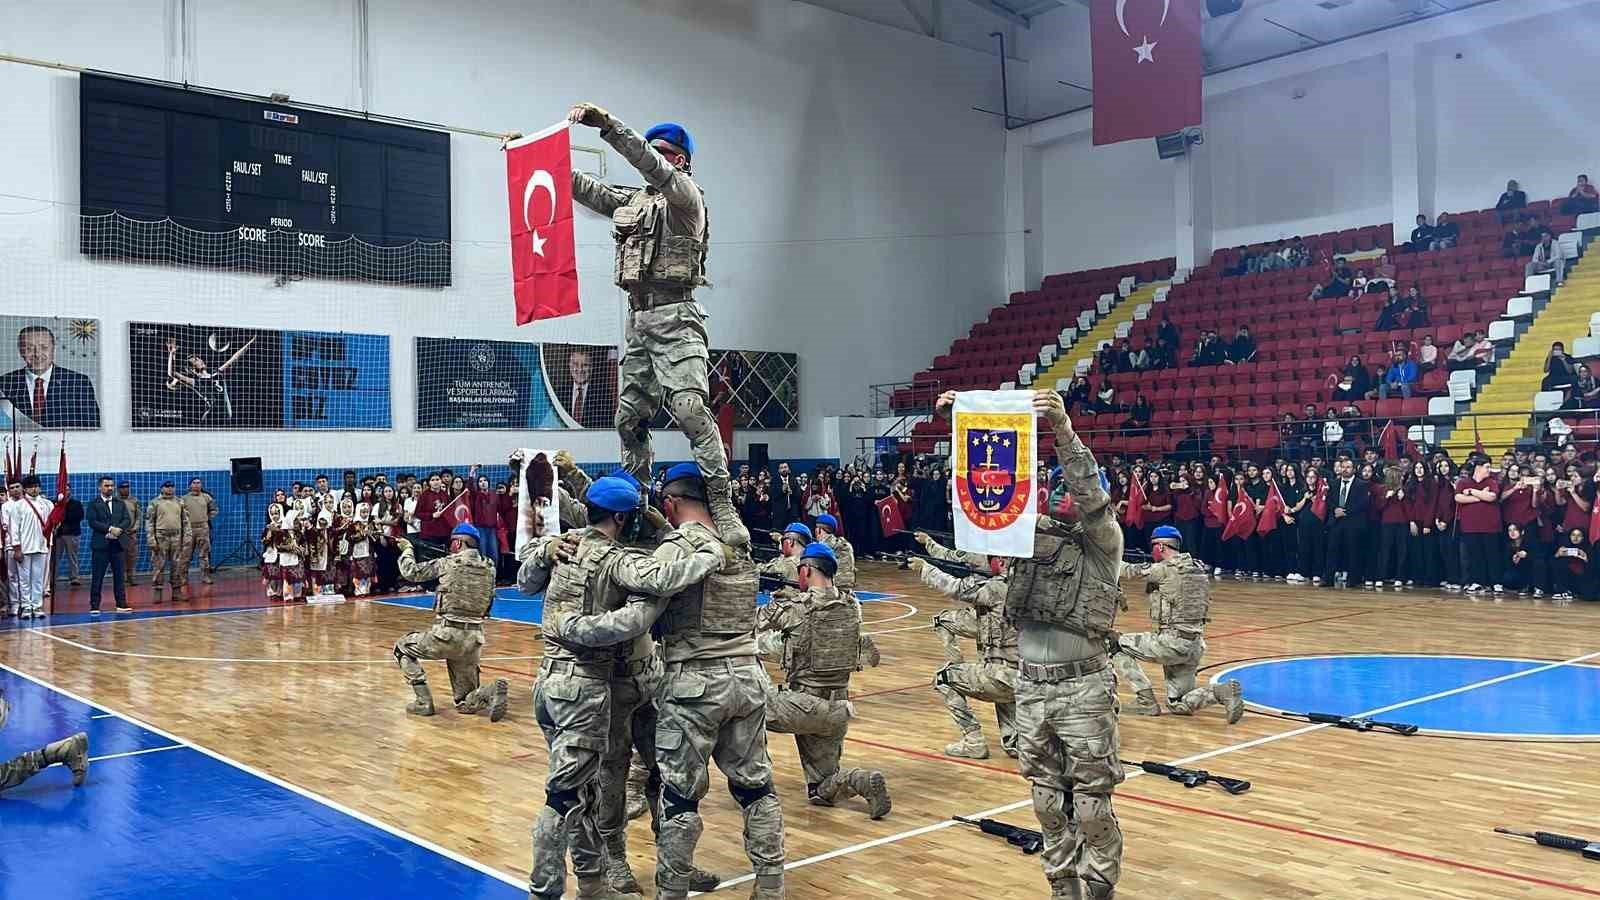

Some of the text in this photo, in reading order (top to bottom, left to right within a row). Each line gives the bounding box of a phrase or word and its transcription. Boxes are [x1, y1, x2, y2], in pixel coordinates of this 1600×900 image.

[274, 153, 293, 165] TIME
[233, 160, 262, 176] FAUL/SET
[301, 169, 329, 185] FAUL/SET
[270, 217, 293, 228] PERIOD
[238, 226, 267, 242] SCORE
[298, 232, 326, 248] SCORE
[447, 387, 455, 396] VE
